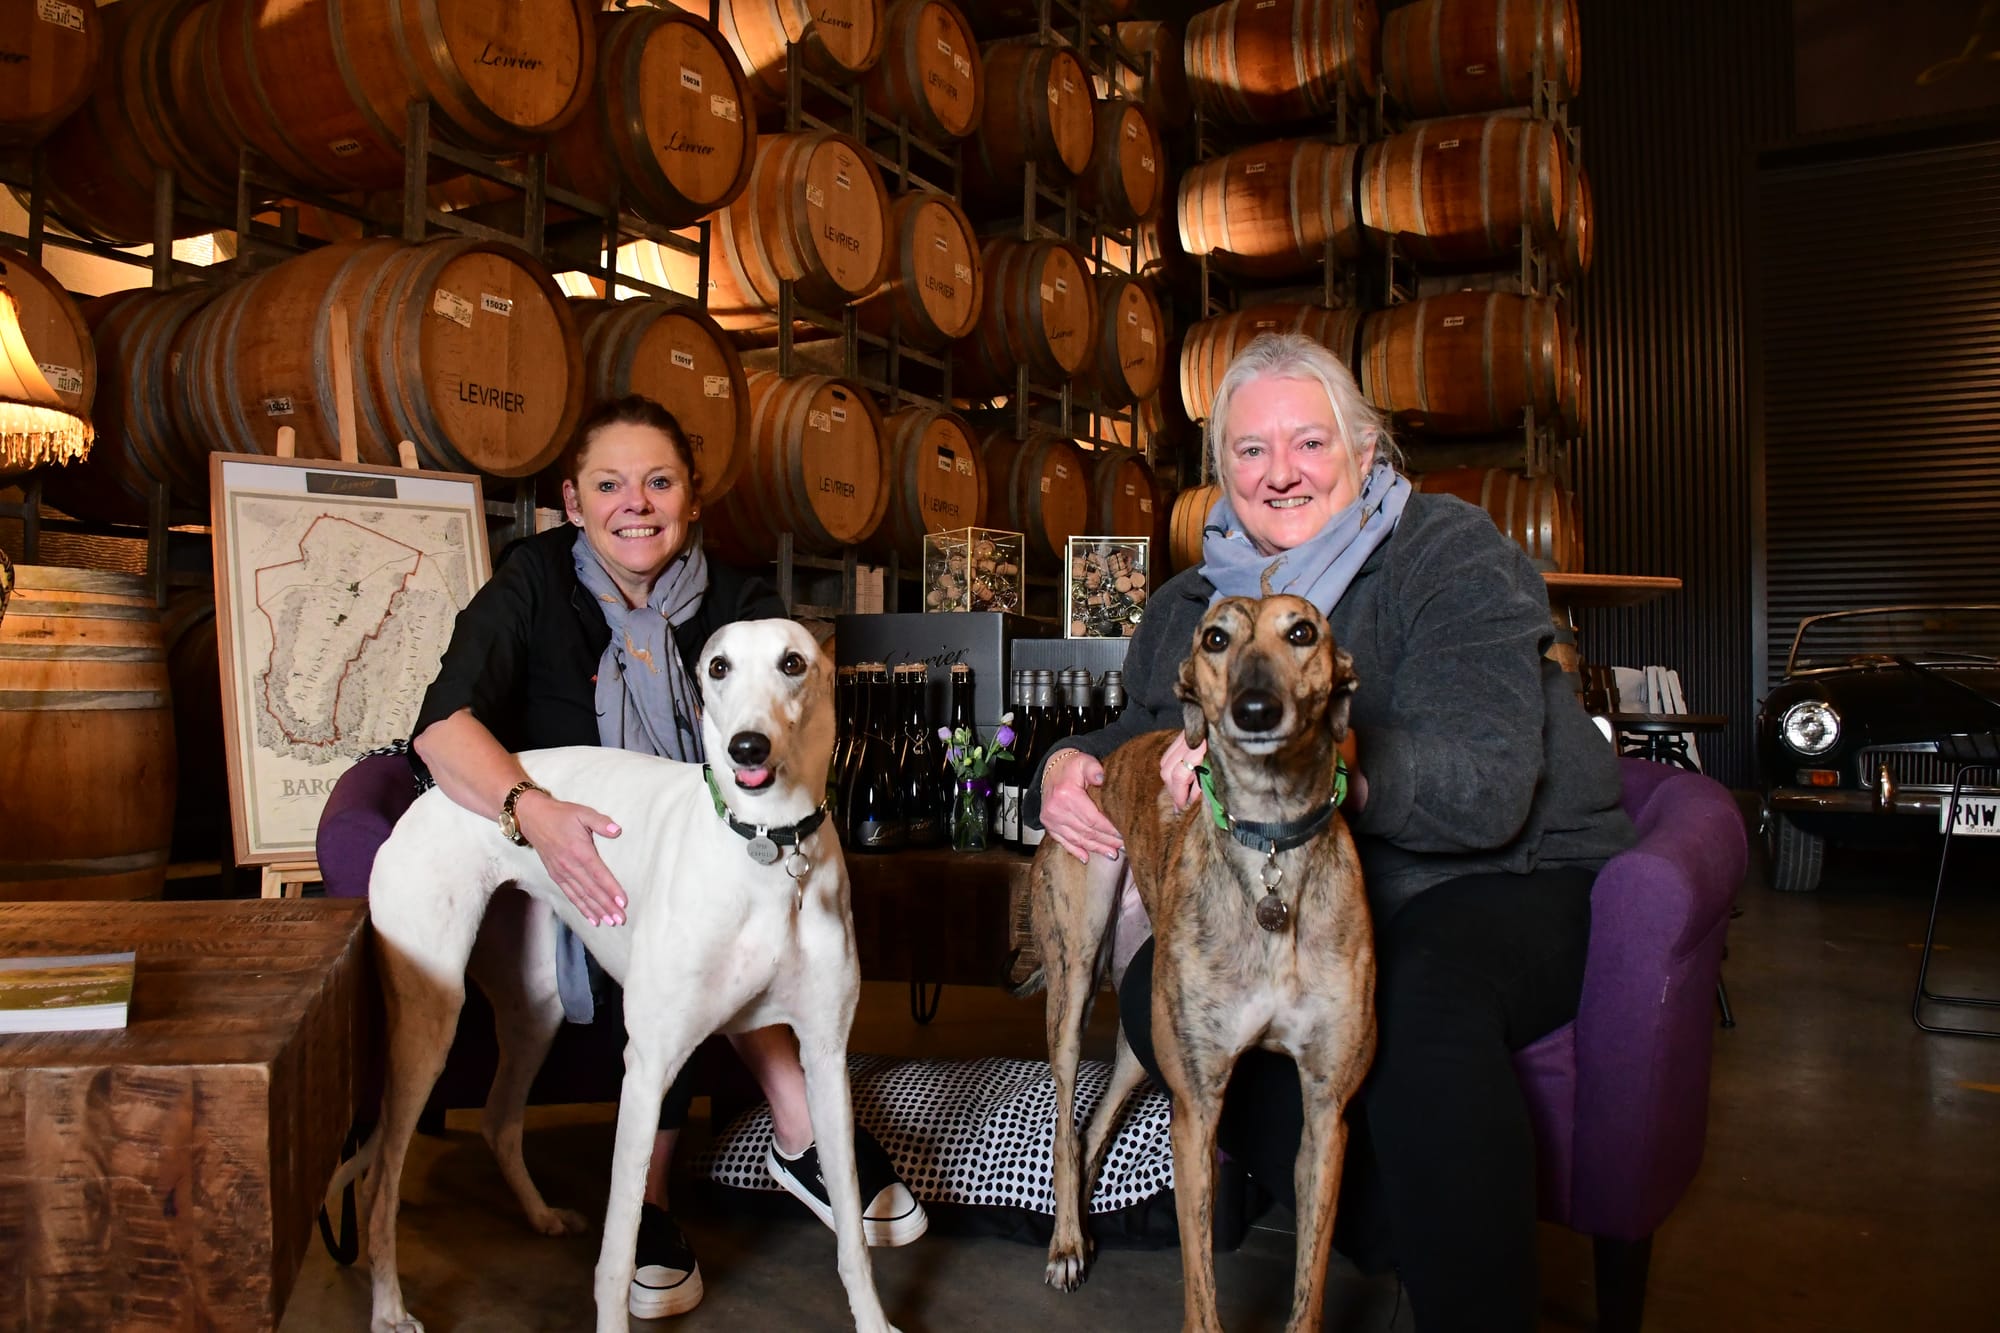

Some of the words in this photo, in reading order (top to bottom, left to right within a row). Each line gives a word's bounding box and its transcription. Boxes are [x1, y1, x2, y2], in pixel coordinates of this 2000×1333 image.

[824, 223, 860, 254] LEVRIER
[925, 274, 955, 299] LEVRIER
[485, 298, 509, 312] 15022
[459, 380, 525, 414] LEVRIER
[819, 475, 856, 499] LEVRIER
